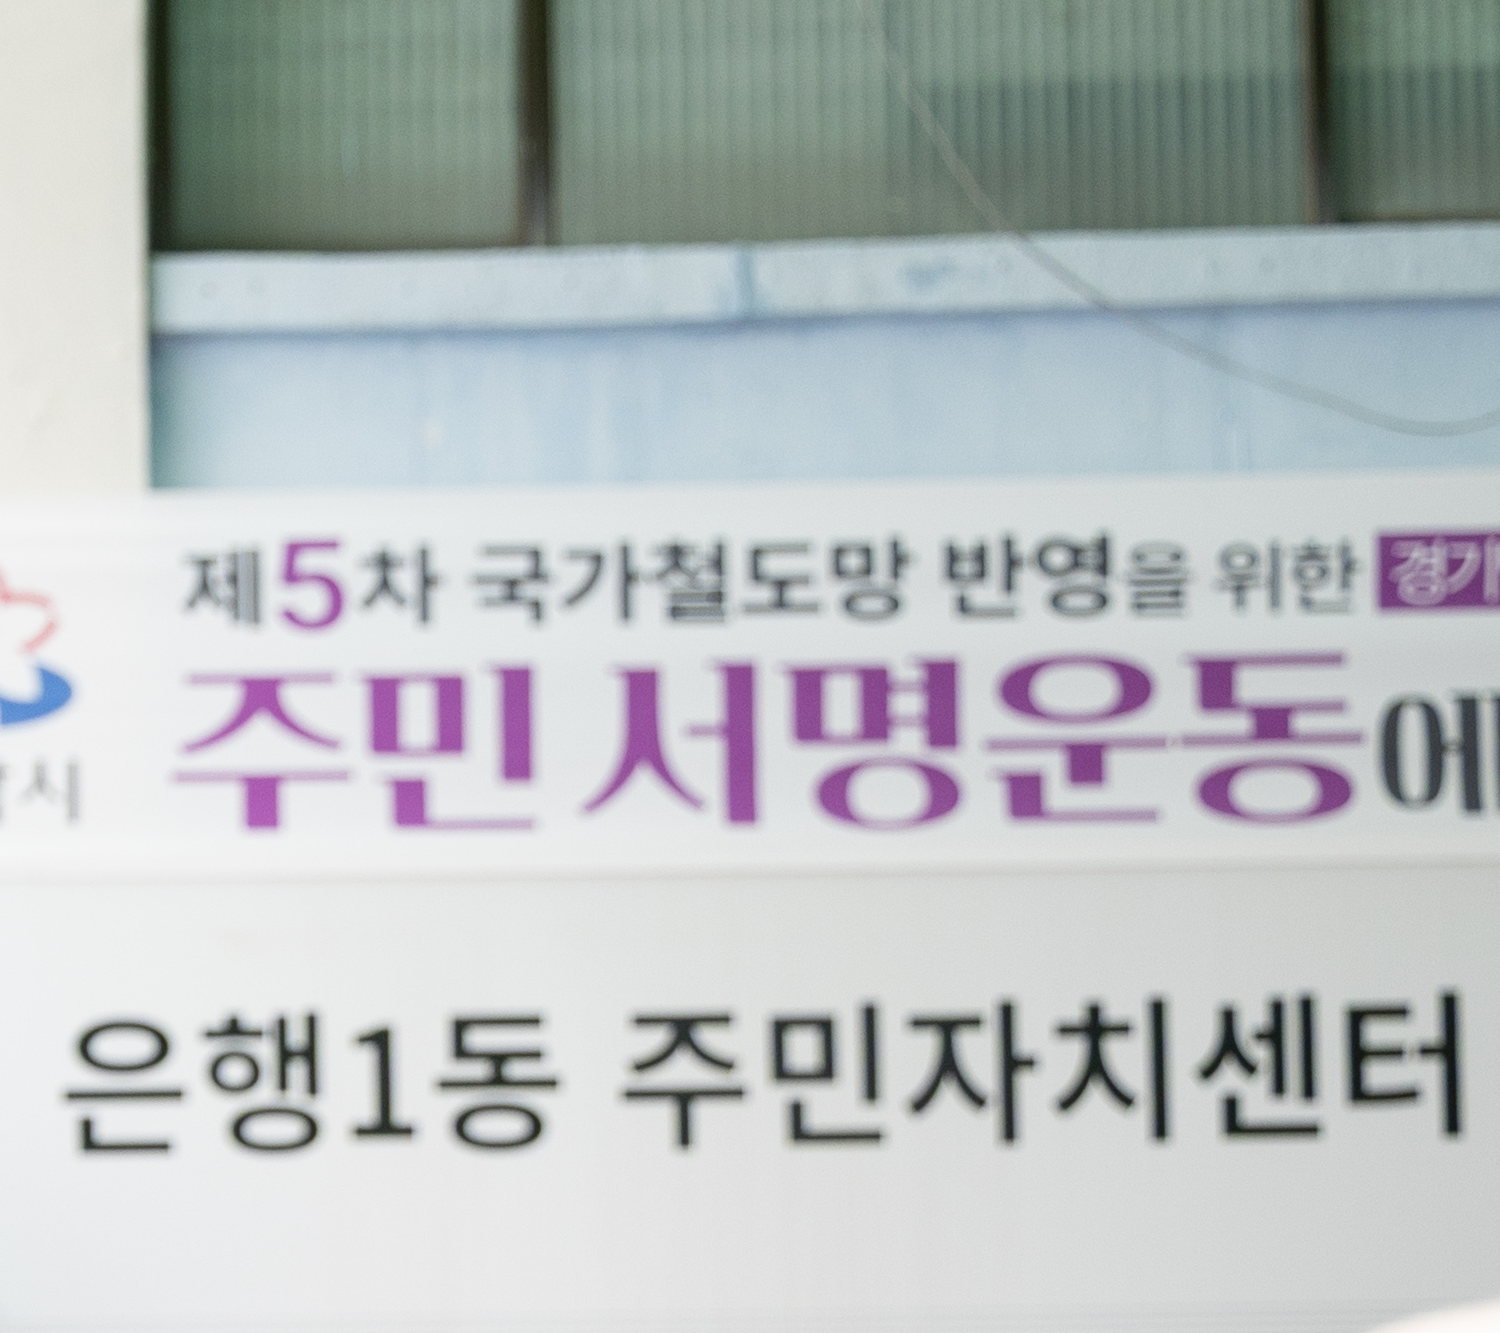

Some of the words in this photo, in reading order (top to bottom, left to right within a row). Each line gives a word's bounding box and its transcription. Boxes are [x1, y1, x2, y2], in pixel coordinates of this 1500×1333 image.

[187, 540, 441, 632] 제5차
[475, 535, 913, 625] 국가철도망
[944, 533, 1190, 618] 반영을
[1216, 537, 1362, 615] 위한
[171, 664, 536, 832] 주민
[63, 1010, 561, 1156] 은행1동
[621, 988, 1465, 1151] 주민자치센터
